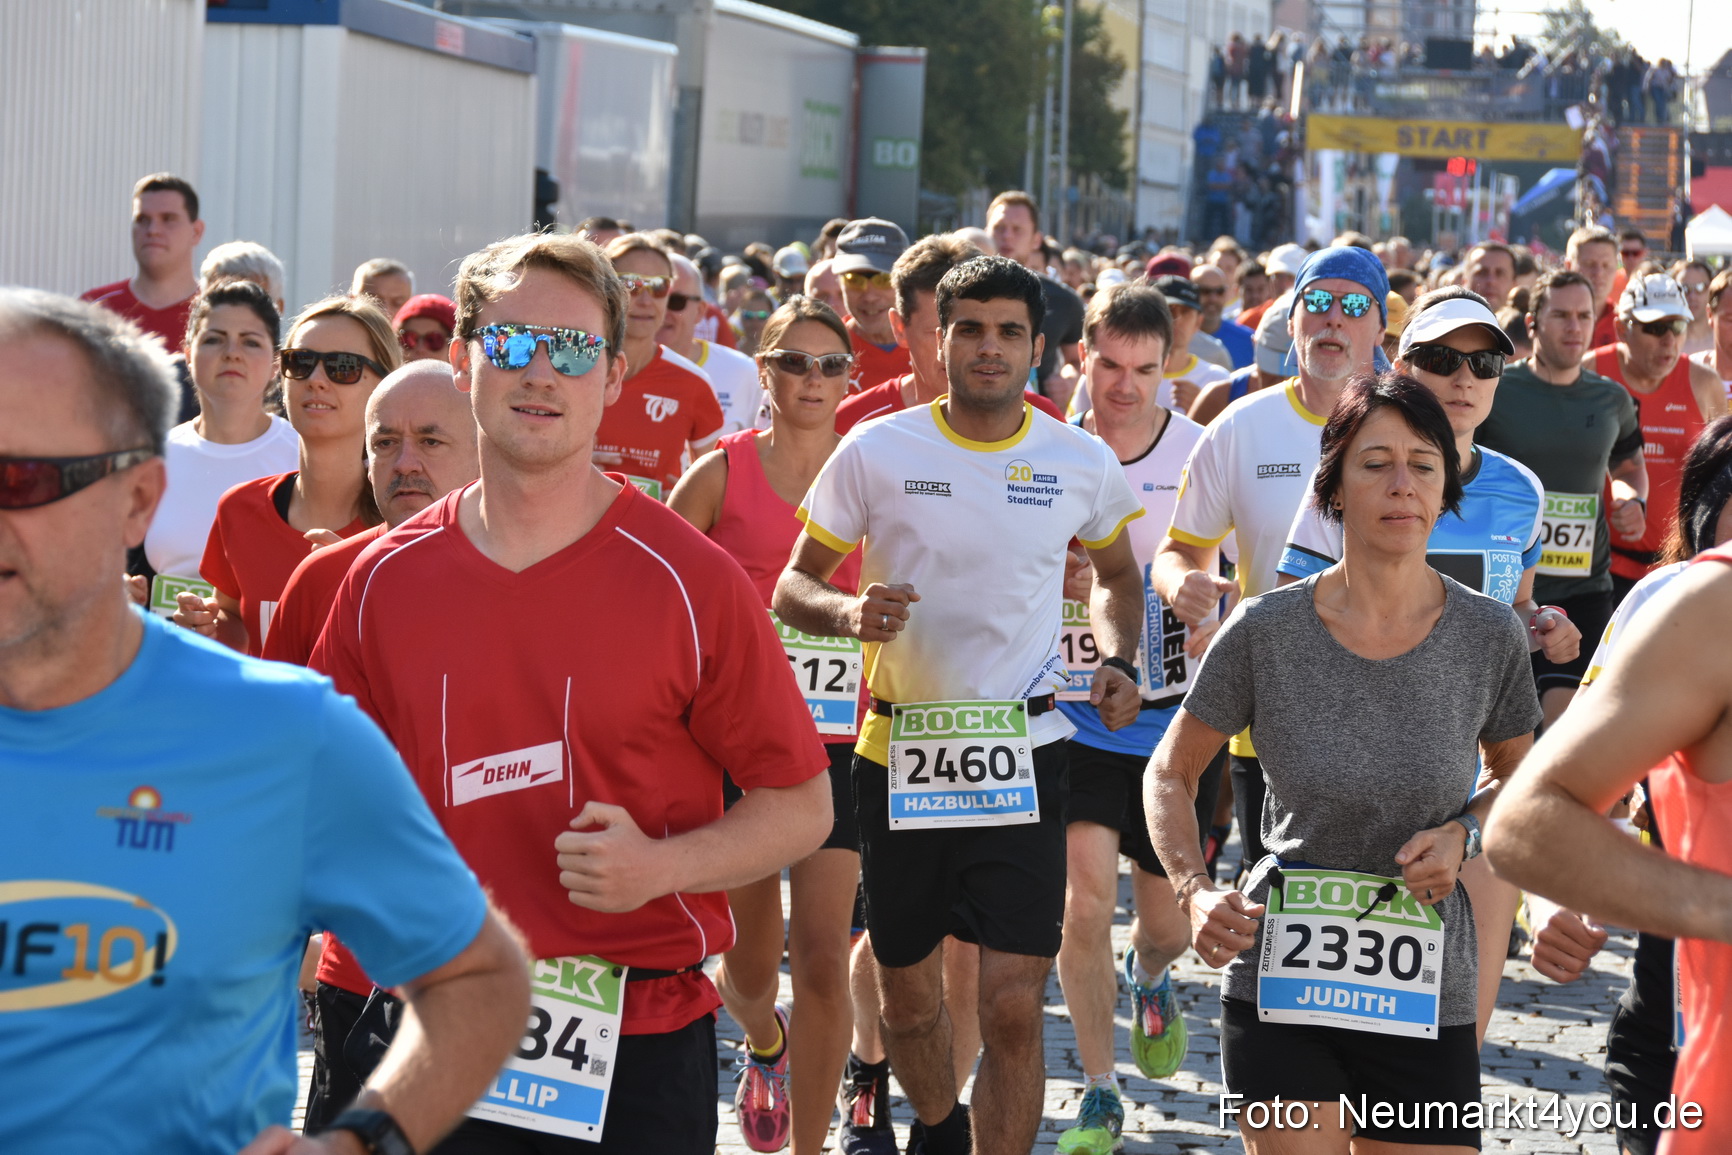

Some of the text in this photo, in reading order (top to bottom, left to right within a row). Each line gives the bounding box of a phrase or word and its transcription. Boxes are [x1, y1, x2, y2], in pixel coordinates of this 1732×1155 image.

[1396, 125, 1492, 150] START
[1008, 465, 1056, 482] 20 JAHRE
[1257, 464, 1301, 475] BOCK
[905, 480, 951, 493] BOCK
[1007, 483, 1064, 496] Neumarkter
[1007, 495, 1053, 508] Stadtlauf
[1492, 553, 1509, 563] POST
[1147, 583, 1163, 684] TECHNOLOGY
[1162, 602, 1187, 688] BER
[902, 707, 1013, 734] BOCK
[1018, 747, 1025, 755] C
[483, 759, 531, 785] DEHN
[905, 745, 1016, 784] 2460
[904, 791, 1022, 812] HAZBULLAH
[1285, 880, 1424, 919] BOCK
[1281, 923, 1422, 981] 2330
[1427, 942, 1436, 952] D
[1296, 985, 1397, 1015] JUDITH
[599, 1028, 608, 1038] C
